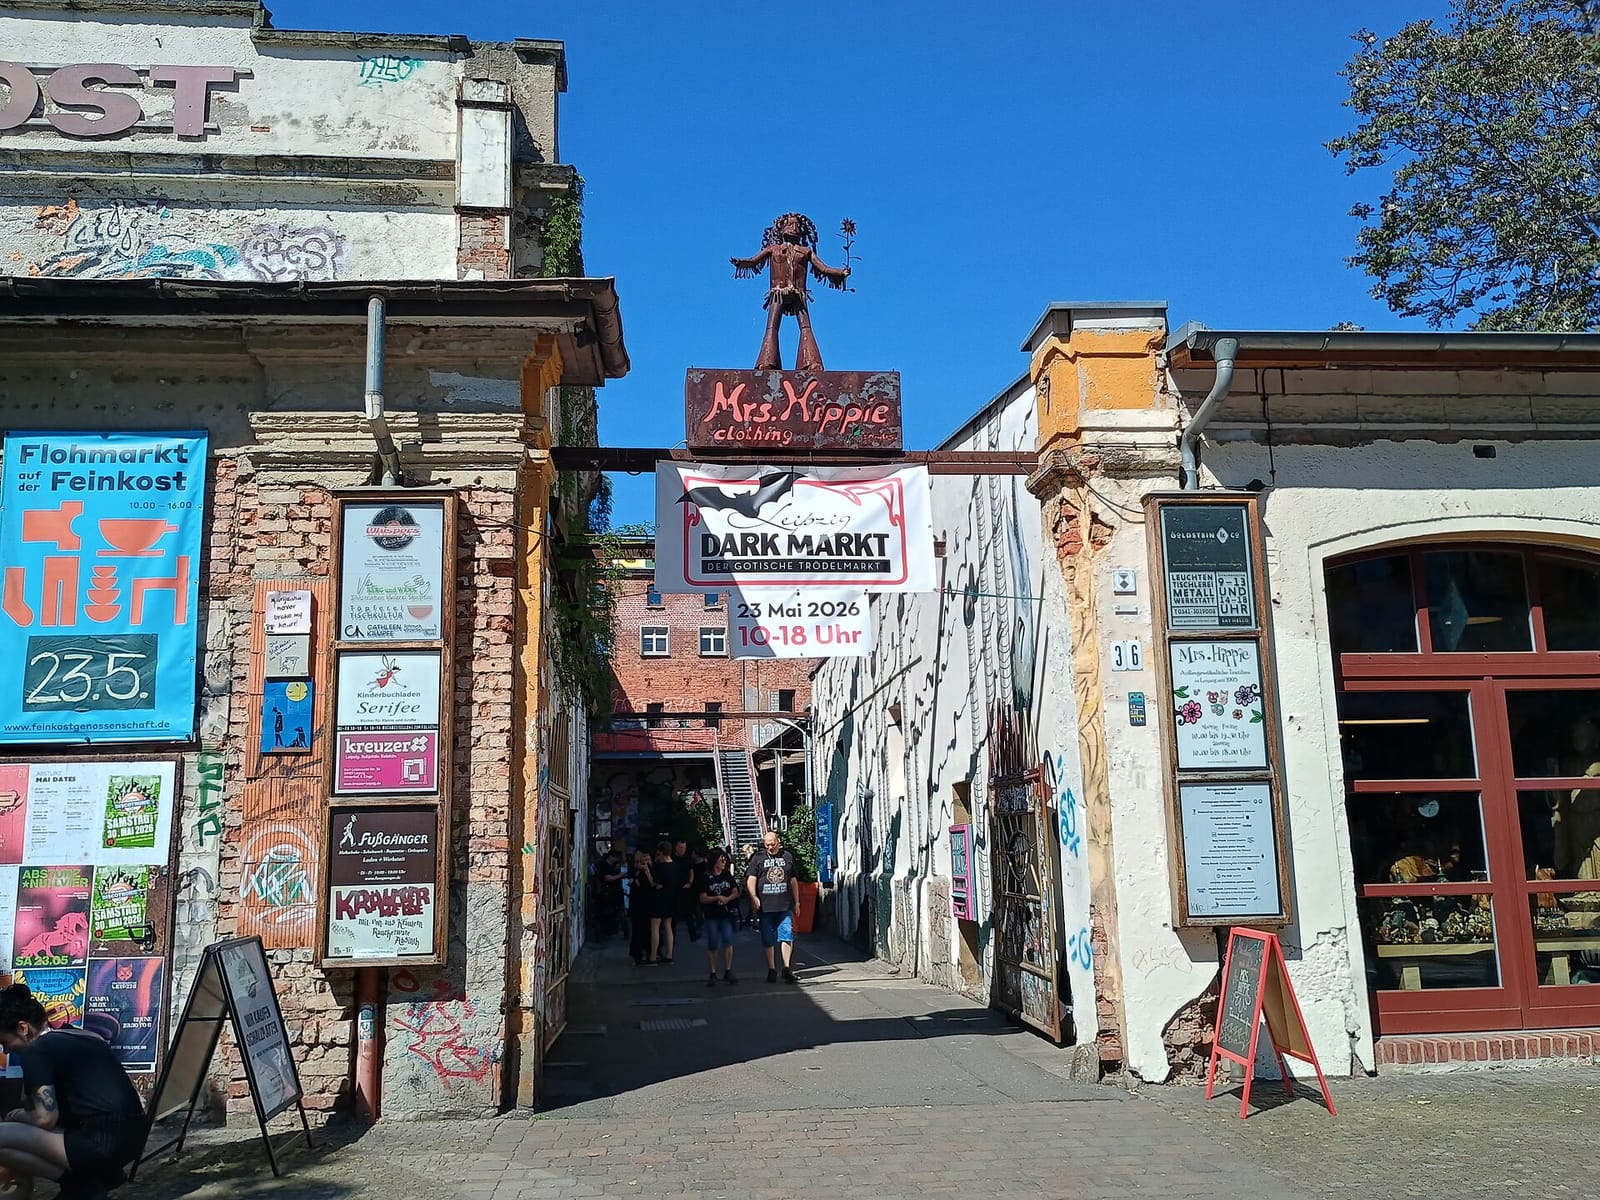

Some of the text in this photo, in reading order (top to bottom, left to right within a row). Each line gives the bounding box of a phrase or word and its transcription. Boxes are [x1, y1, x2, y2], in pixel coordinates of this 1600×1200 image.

[703, 379, 890, 434] Mrs. Hippie
[713, 426, 794, 444] clothing
[20, 444, 189, 464] Flohmarkt
[18, 471, 42, 480] auf
[51, 471, 188, 492] Feinkost
[18, 484, 40, 492] der
[130, 502, 156, 510] 10.00
[167, 501, 192, 510] 16.00
[727, 503, 852, 536] Leipzig
[701, 533, 889, 558] DARK MARKT
[707, 560, 882, 571] DER GOTISCHE TRÖDELMARKT
[1173, 589, 1215, 597] METALL
[1218, 587, 1246, 596] UND
[737, 602, 861, 618] 23 Mai 2026
[1220, 604, 1248, 615] UHR
[738, 624, 863, 648] 10-18 Uhr
[26, 651, 149, 704] 23.5.
[357, 691, 421, 699] Kinderbuchladen
[357, 701, 421, 716] Serifee
[4, 720, 171, 732] www.feinkostgenossenschaft.de
[345, 738, 411, 753] kreuzer
[15, 955, 69, 966] SA 23.05
